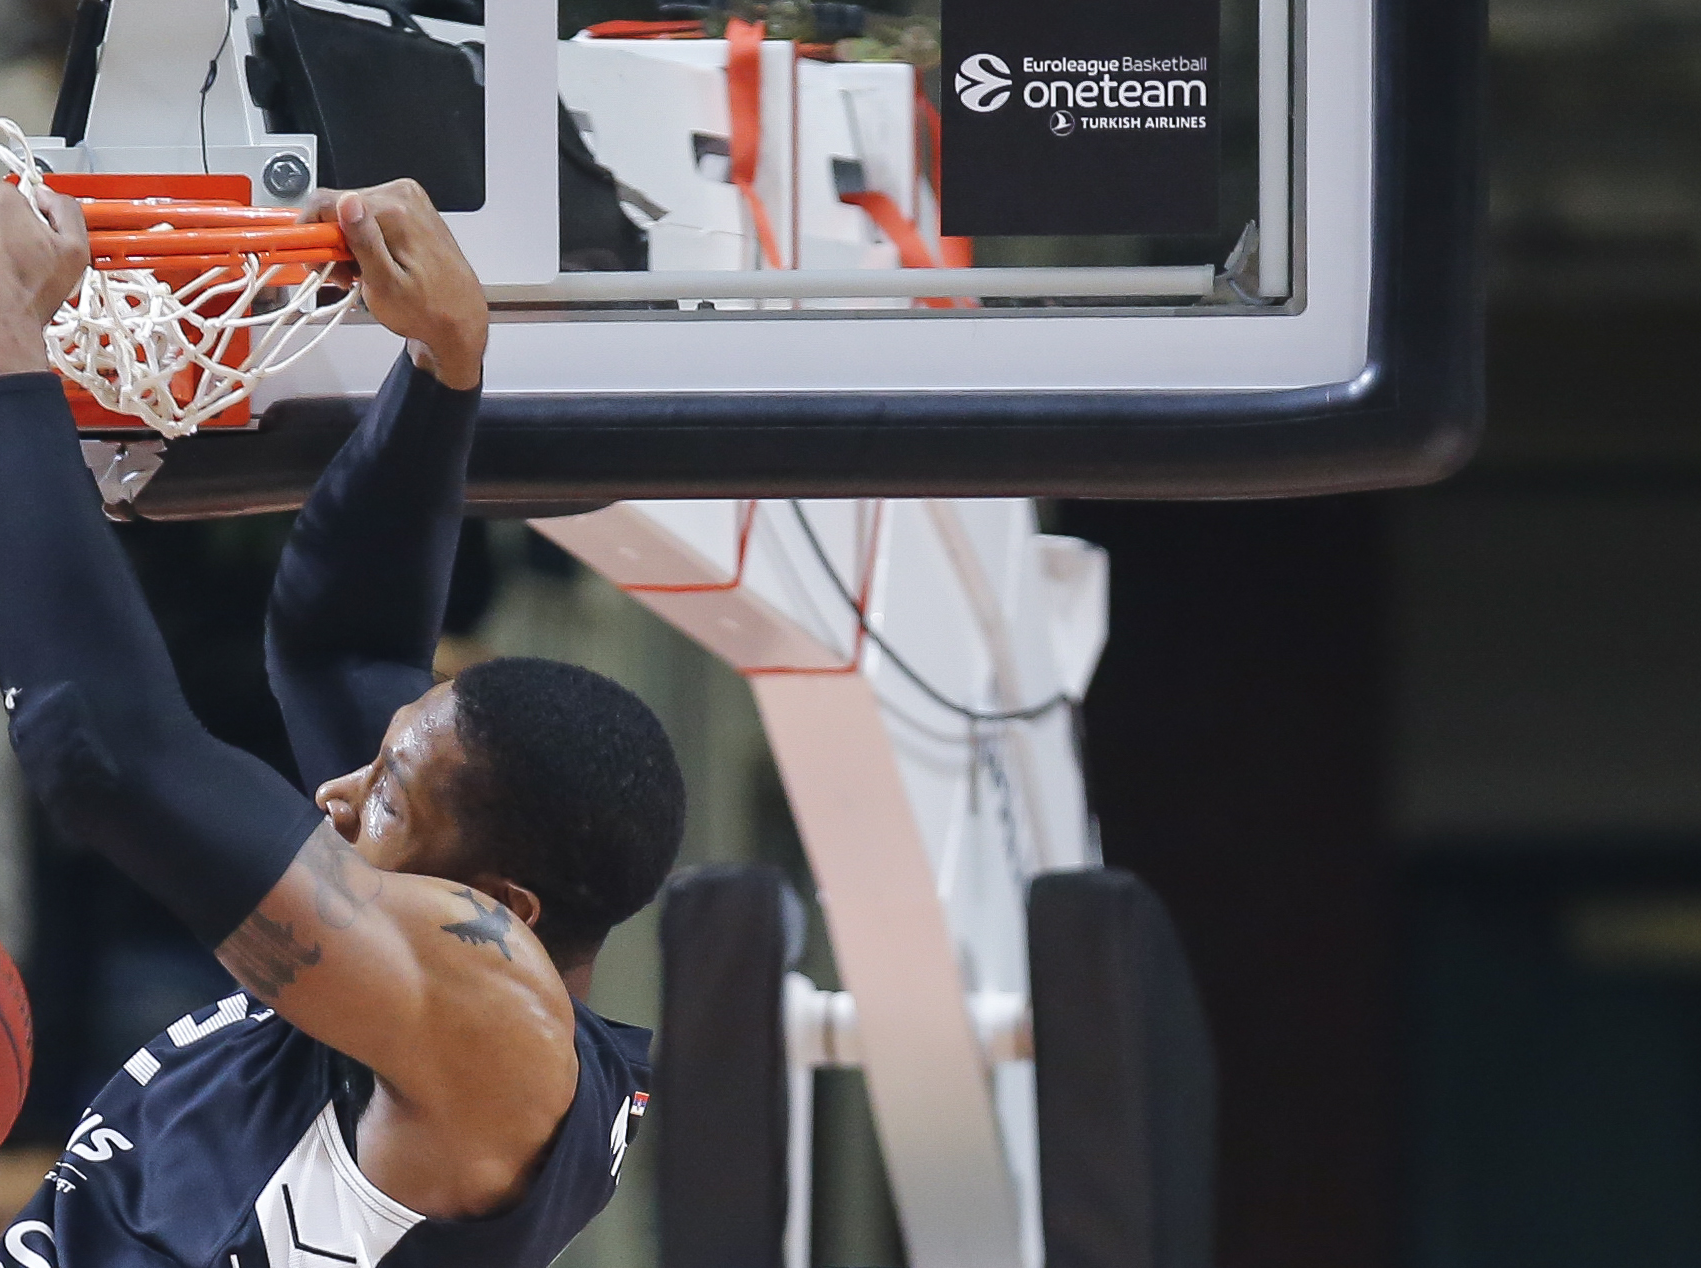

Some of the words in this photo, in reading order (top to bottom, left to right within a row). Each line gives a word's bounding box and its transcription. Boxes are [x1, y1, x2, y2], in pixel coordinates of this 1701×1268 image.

[1023, 56, 1120, 76] Euroleague
[1122, 55, 1208, 72] Basketball
[1023, 73, 1208, 109] oneteam
[1080, 116, 1141, 130] TURKISH
[1144, 115, 1207, 130] AIRLINES
